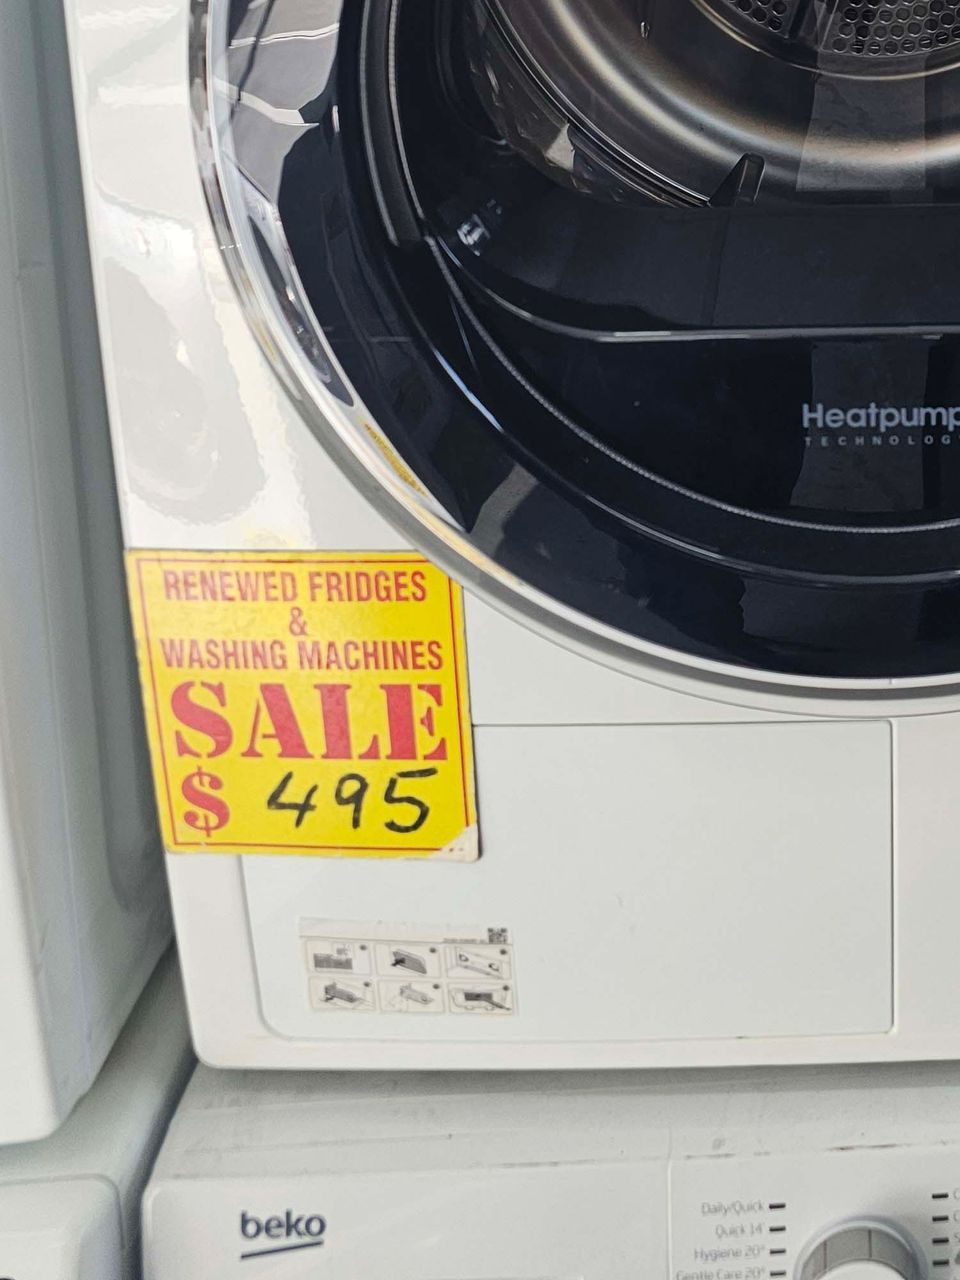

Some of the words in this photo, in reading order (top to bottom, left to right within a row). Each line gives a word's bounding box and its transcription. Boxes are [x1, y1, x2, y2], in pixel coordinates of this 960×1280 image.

[164, 569, 298, 602] RENEWED
[308, 570, 427, 602] FRIDGES
[289, 605, 309, 637] &
[159, 637, 289, 670] WASHING
[299, 639, 444, 671] MACHINES
[170, 680, 448, 761] SALE
[181, 766, 231, 837] $
[266, 767, 439, 834] 495
[240, 1209, 327, 1239] beko
[715, 1223, 746, 1239] Quick
[694, 1247, 743, 1263] Hygiene
